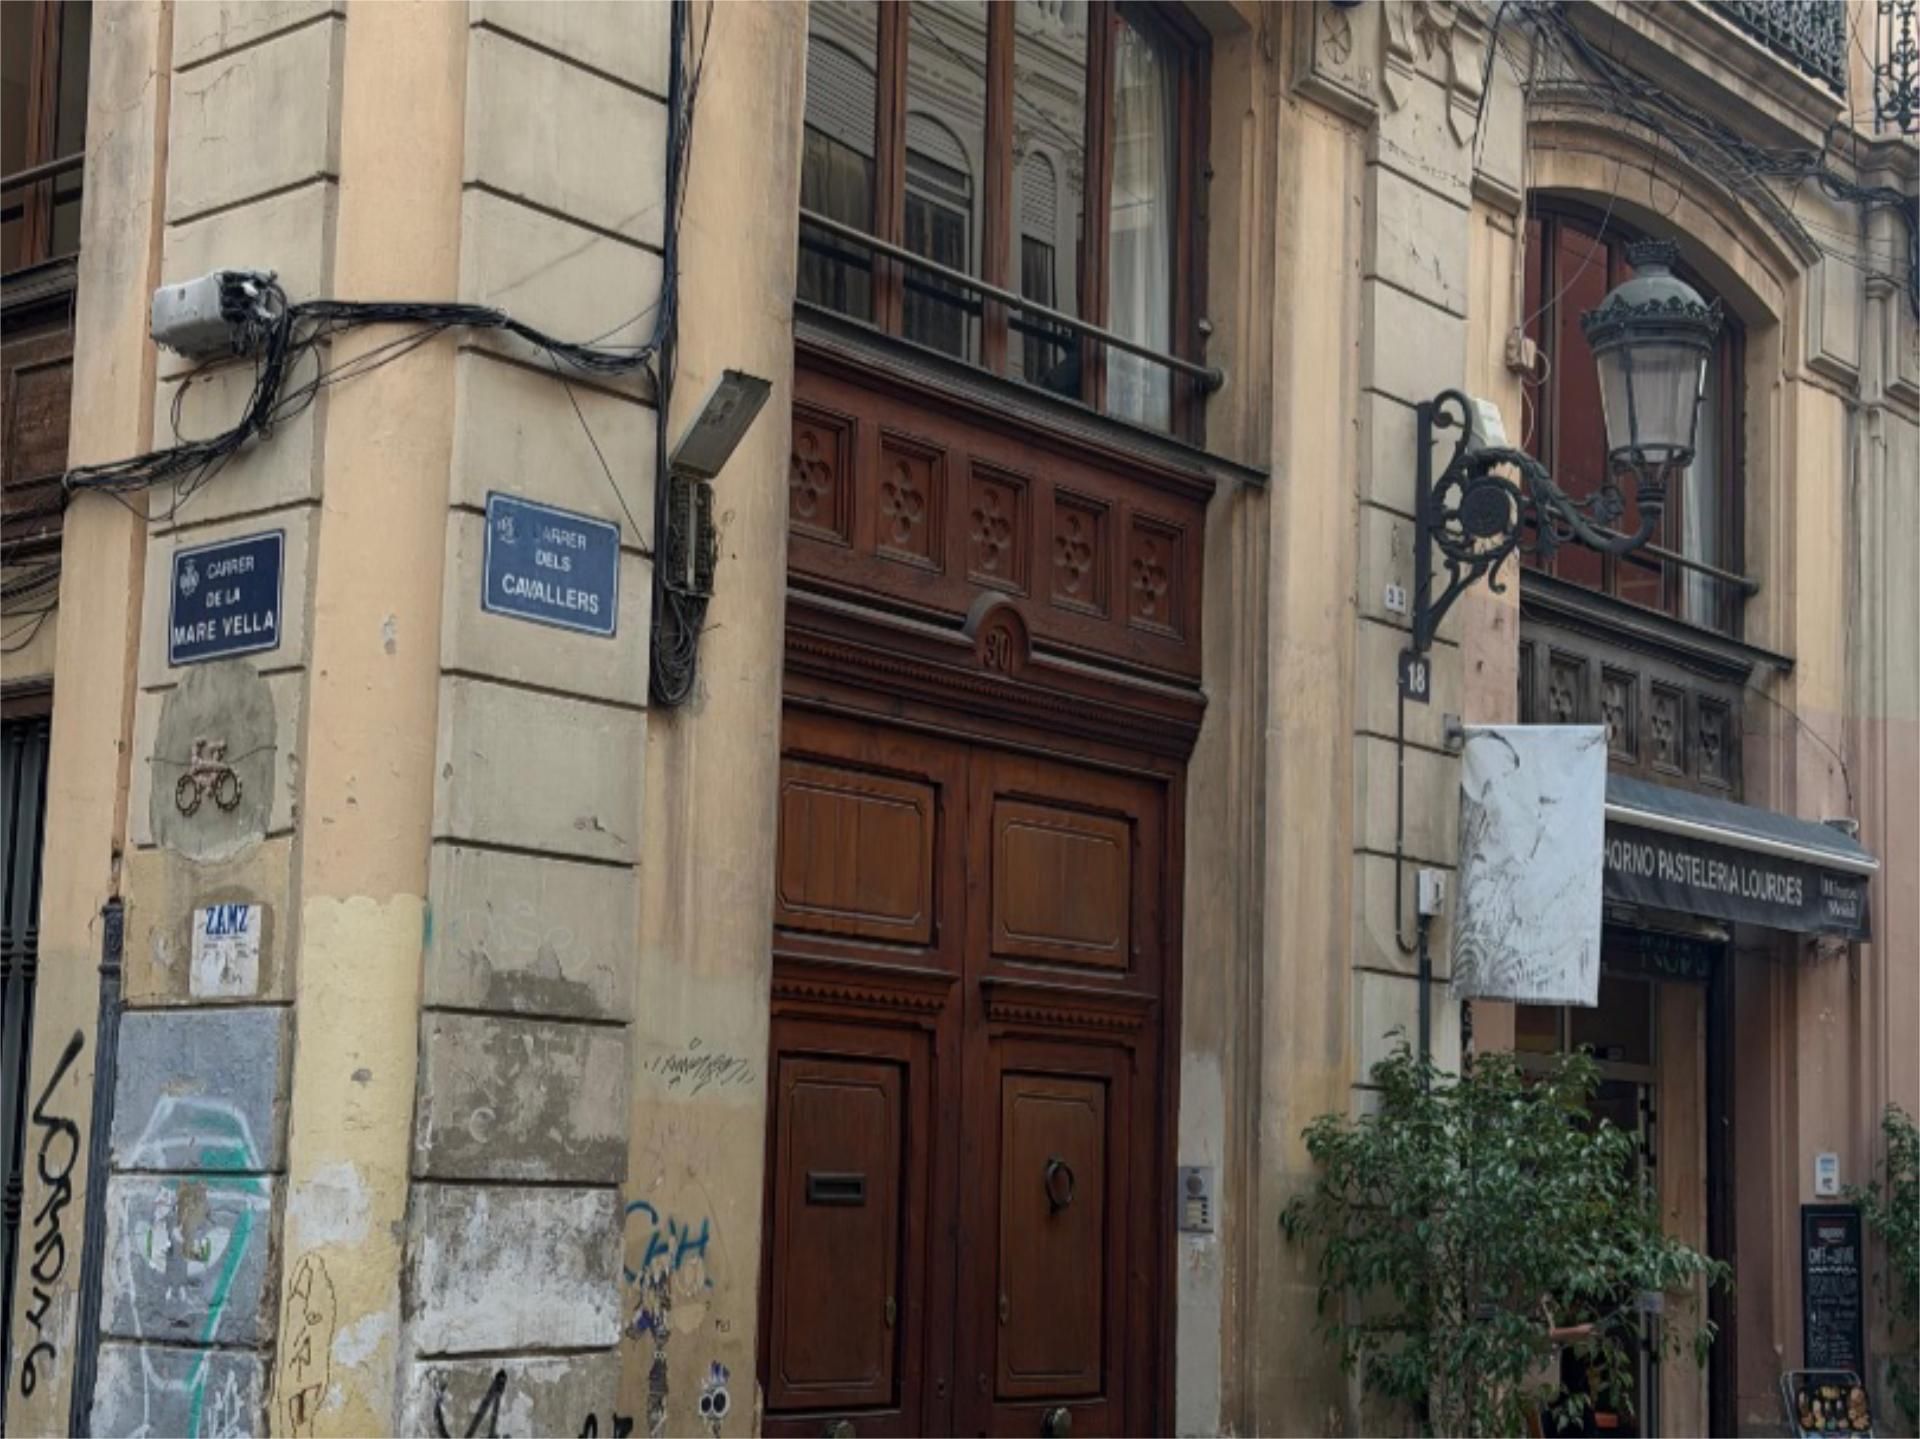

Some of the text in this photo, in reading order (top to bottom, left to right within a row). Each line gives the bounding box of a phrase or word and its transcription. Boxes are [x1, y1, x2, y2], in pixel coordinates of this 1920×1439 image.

[534, 524, 588, 551] ARRER
[206, 555, 256, 580] CARRER
[534, 548, 572, 573] DELS
[206, 586, 241, 608] DE LA
[501, 573, 599, 615] CAVALLERS
[174, 609, 274, 646] MARE VELLA
[1408, 660, 1426, 694] 18
[1741, 866, 1803, 907] LOURDES
